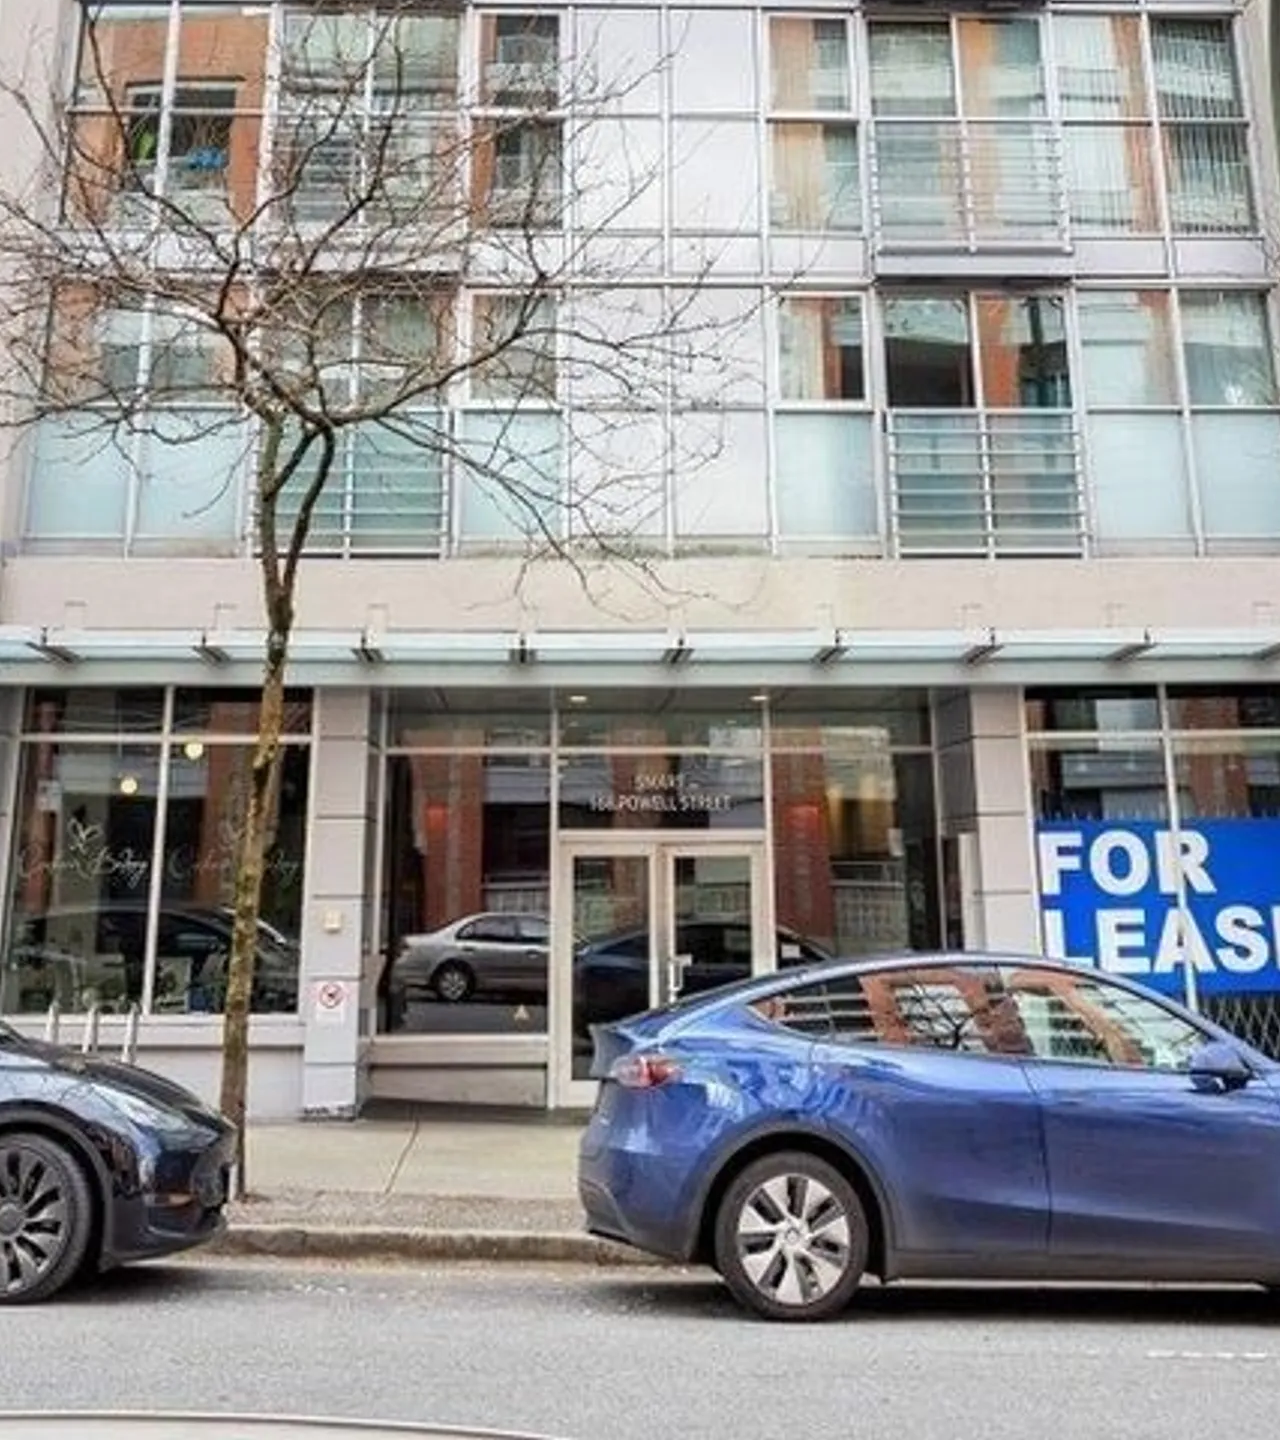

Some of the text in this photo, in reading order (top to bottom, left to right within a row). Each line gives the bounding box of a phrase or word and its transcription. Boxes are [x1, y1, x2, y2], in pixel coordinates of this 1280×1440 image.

[618, 793, 677, 811] POWELL
[679, 793, 731, 811] STREET
[1038, 829, 1217, 896] FOR
